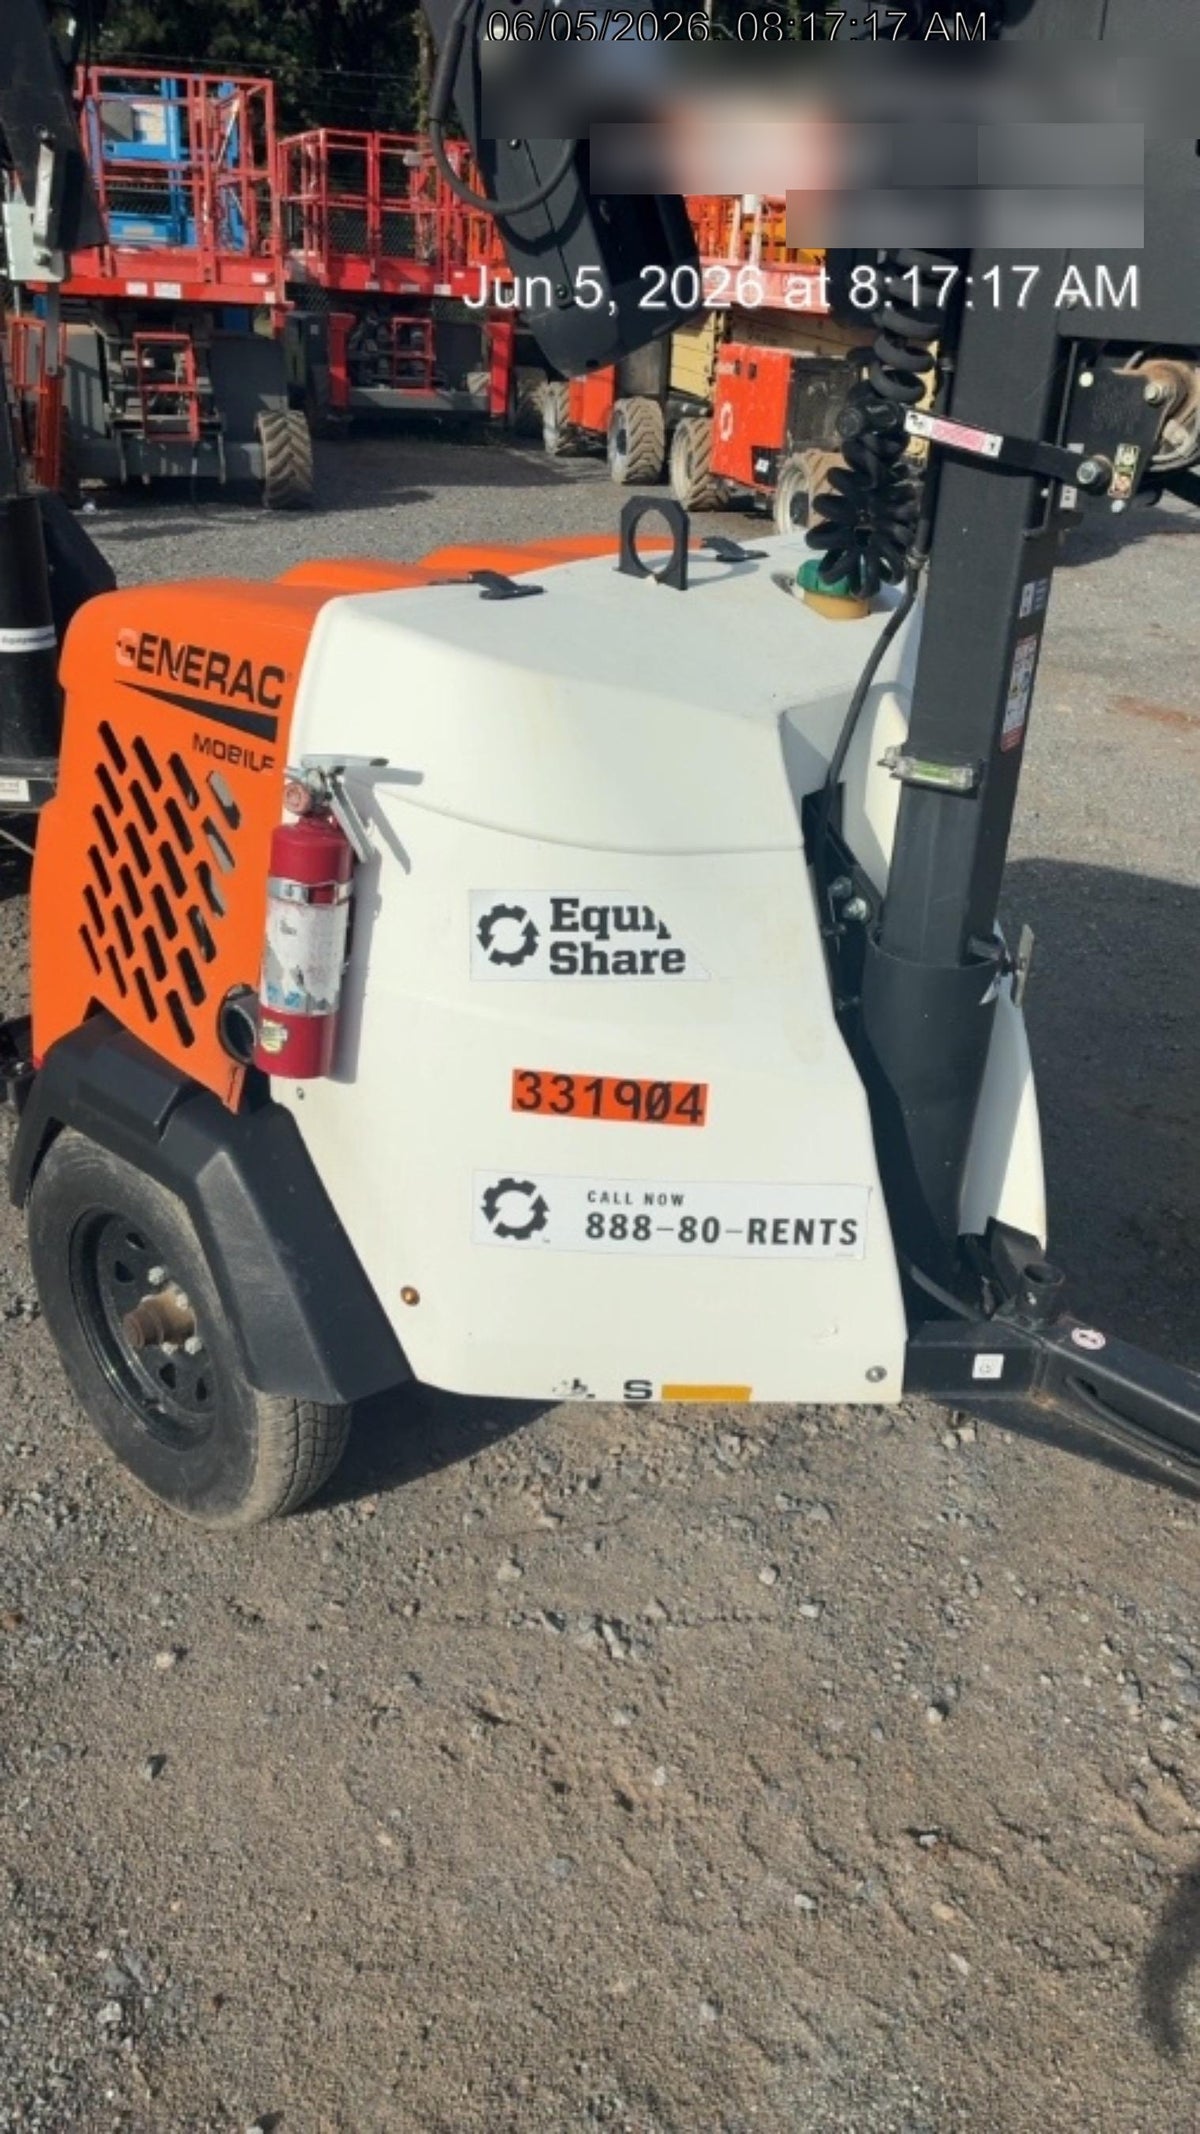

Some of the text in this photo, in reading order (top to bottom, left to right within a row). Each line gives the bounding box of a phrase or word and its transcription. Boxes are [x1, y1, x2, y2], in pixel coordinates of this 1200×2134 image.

[116, 628, 285, 709] GENERAC
[550, 898, 671, 941] Equi
[550, 941, 686, 975] Share
[516, 1071, 704, 1123] 331904
[587, 1190, 684, 1207] CALL NOW
[585, 1212, 858, 1246] 888-80-RENTS
